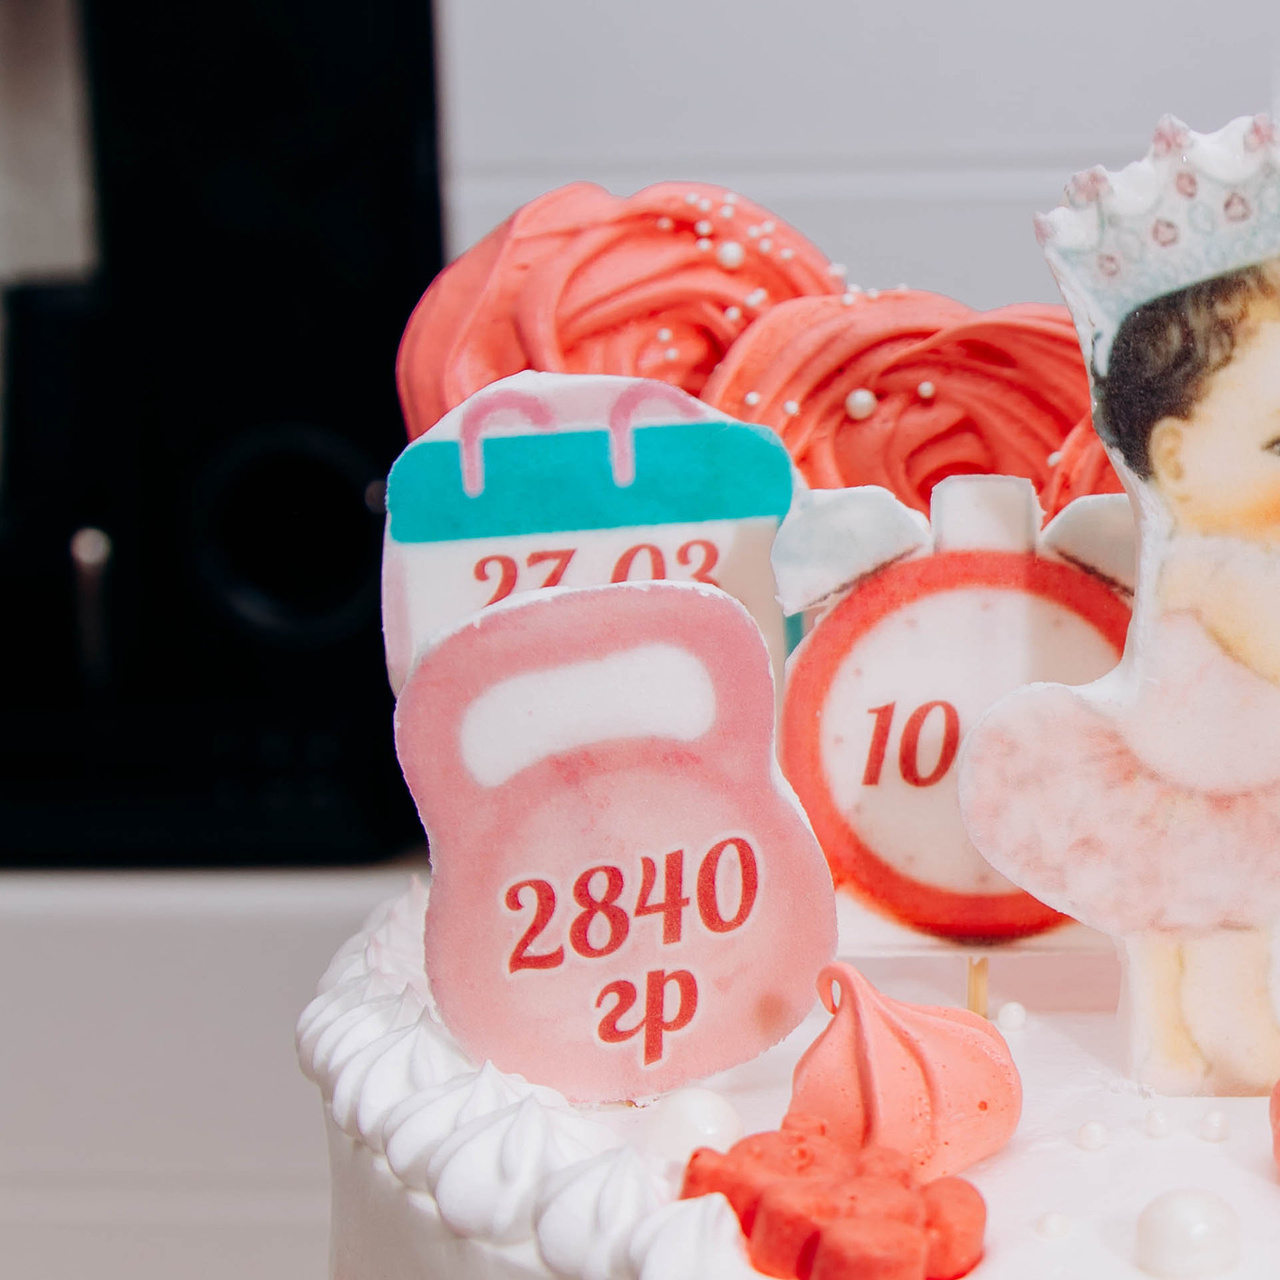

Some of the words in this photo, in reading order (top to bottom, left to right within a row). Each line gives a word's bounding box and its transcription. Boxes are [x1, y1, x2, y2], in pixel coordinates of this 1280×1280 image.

[860, 700, 963, 792] 10
[504, 837, 760, 975] 2840
[595, 968, 699, 1066] гр
